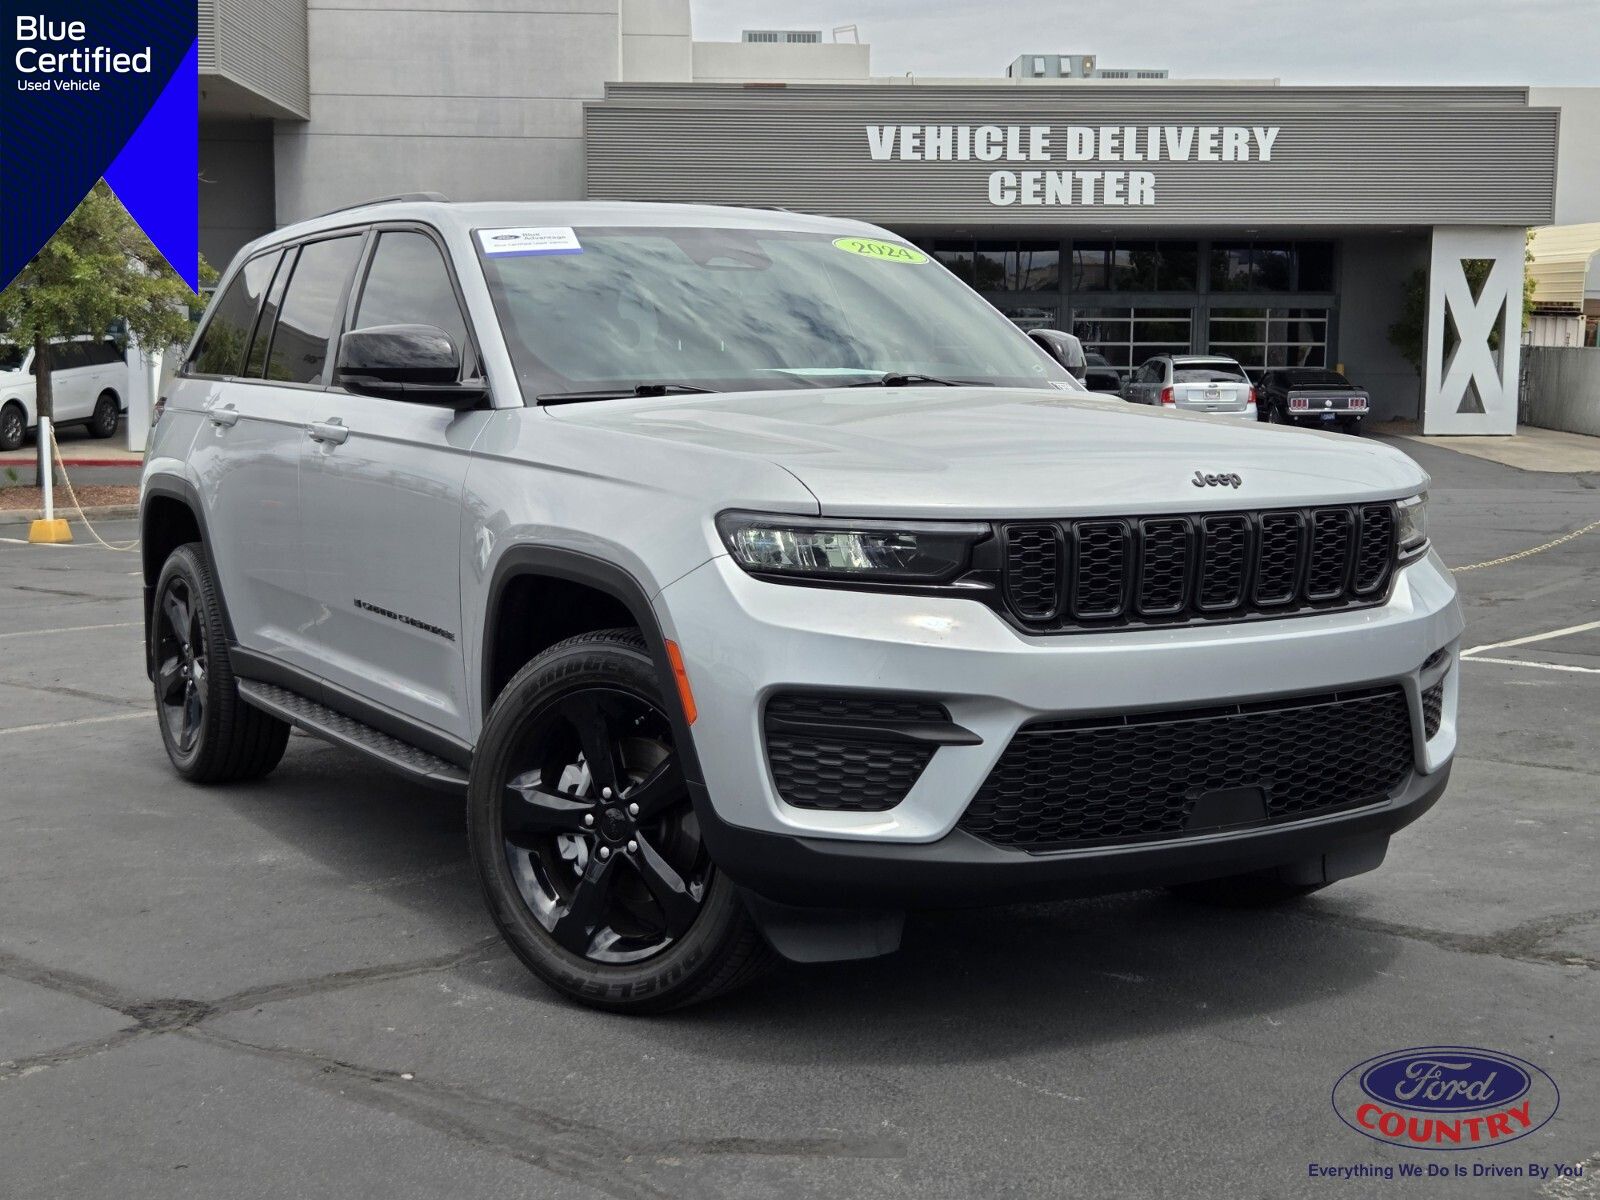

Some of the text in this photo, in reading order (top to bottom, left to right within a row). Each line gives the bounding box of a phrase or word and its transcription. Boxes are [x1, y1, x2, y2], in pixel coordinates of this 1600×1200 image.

[866, 125, 1280, 161] VEHICLE DELIVERY
[988, 170, 1156, 206] CENTER
[851, 241, 913, 260] 2024
[1191, 470, 1242, 489] Jeep
